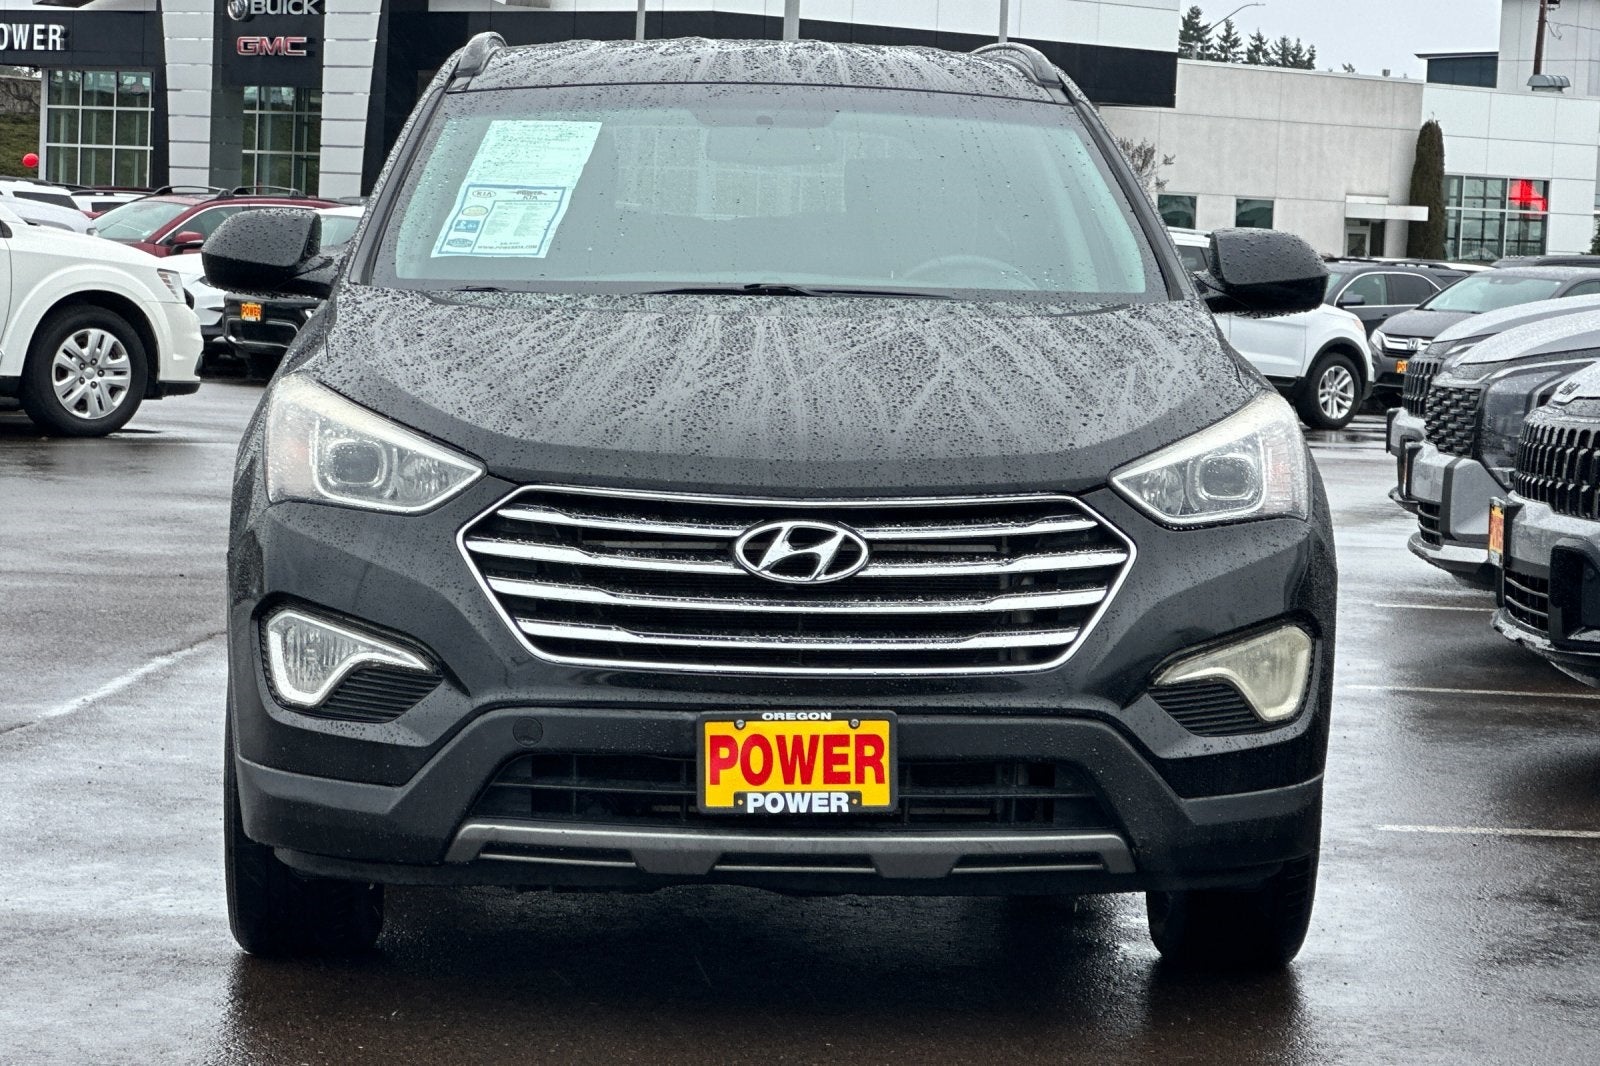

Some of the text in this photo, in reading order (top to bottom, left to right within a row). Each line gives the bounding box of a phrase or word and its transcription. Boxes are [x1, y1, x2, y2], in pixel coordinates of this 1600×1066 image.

[249, 0, 319, 15] BUICK
[236, 36, 307, 56] GMC
[761, 712, 832, 721] OREGON
[709, 734, 886, 786] POWER
[746, 792, 850, 814] POWER
